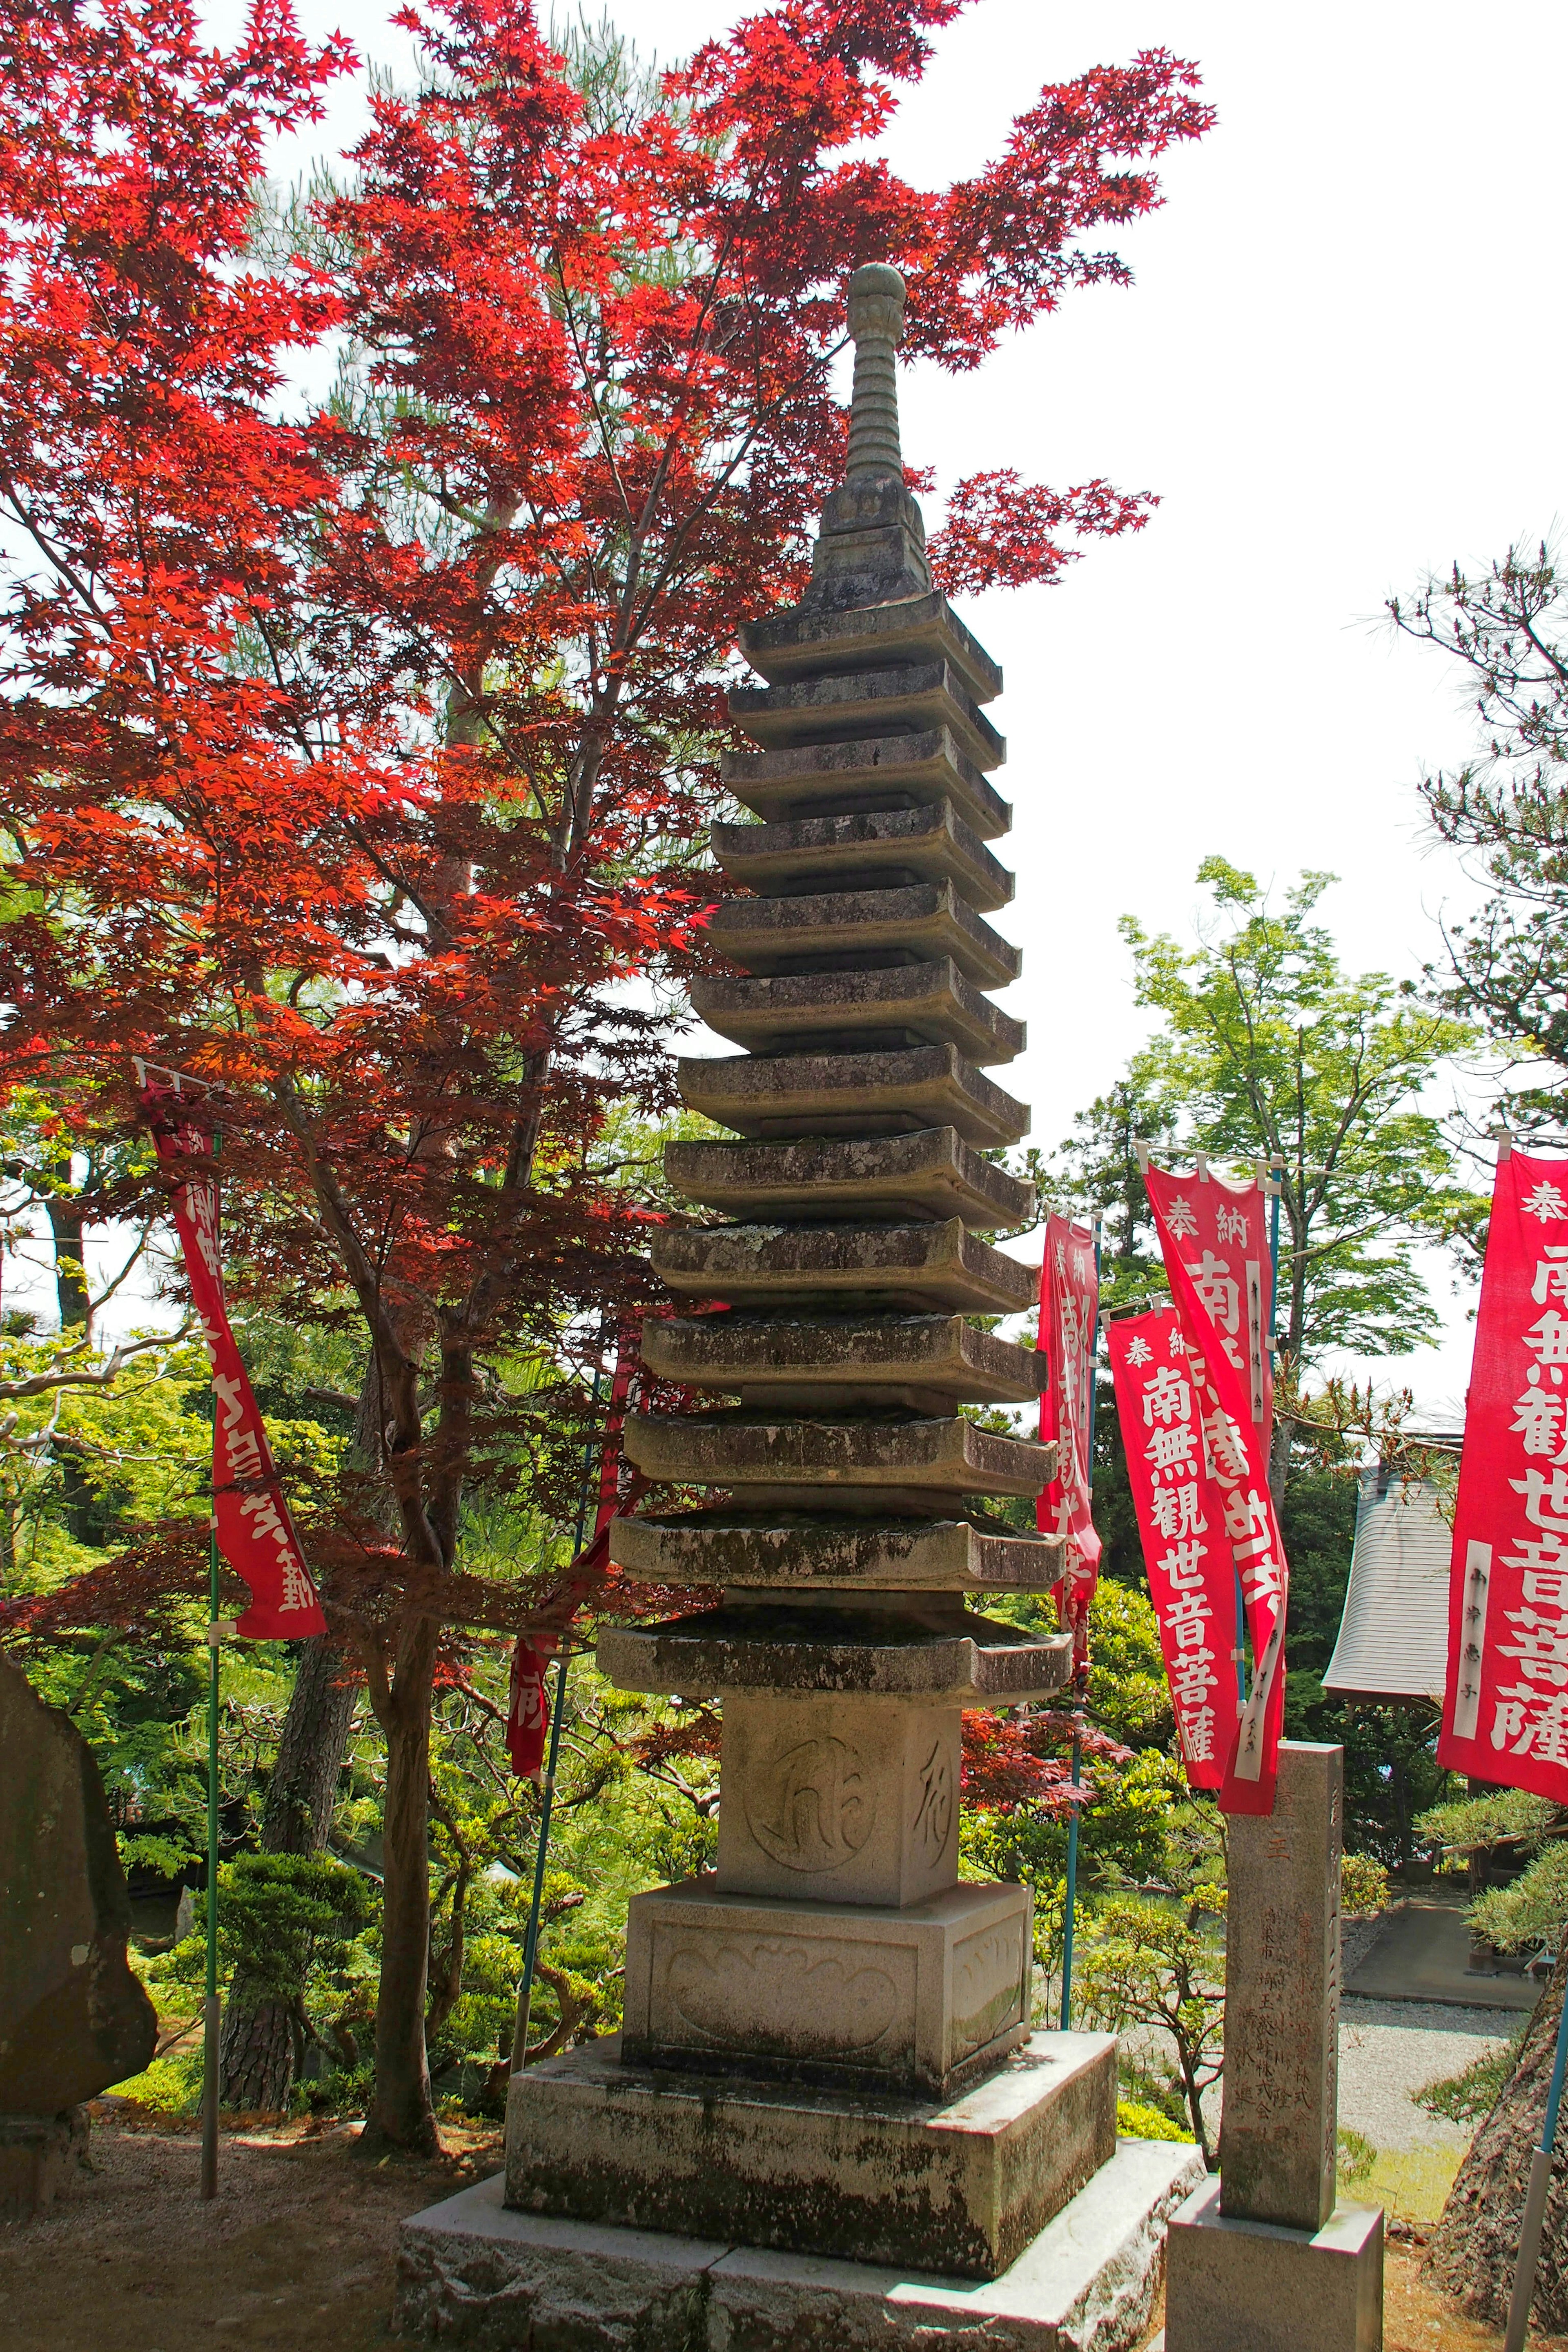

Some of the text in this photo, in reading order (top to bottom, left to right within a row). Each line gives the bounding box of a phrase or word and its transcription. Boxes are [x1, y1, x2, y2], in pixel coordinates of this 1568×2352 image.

[1162, 1194, 1247, 1249] 奉納
[1250, 1280, 1262, 1408] 身体健全
[1142, 1366, 1219, 1763] 南無観世音菩薩
